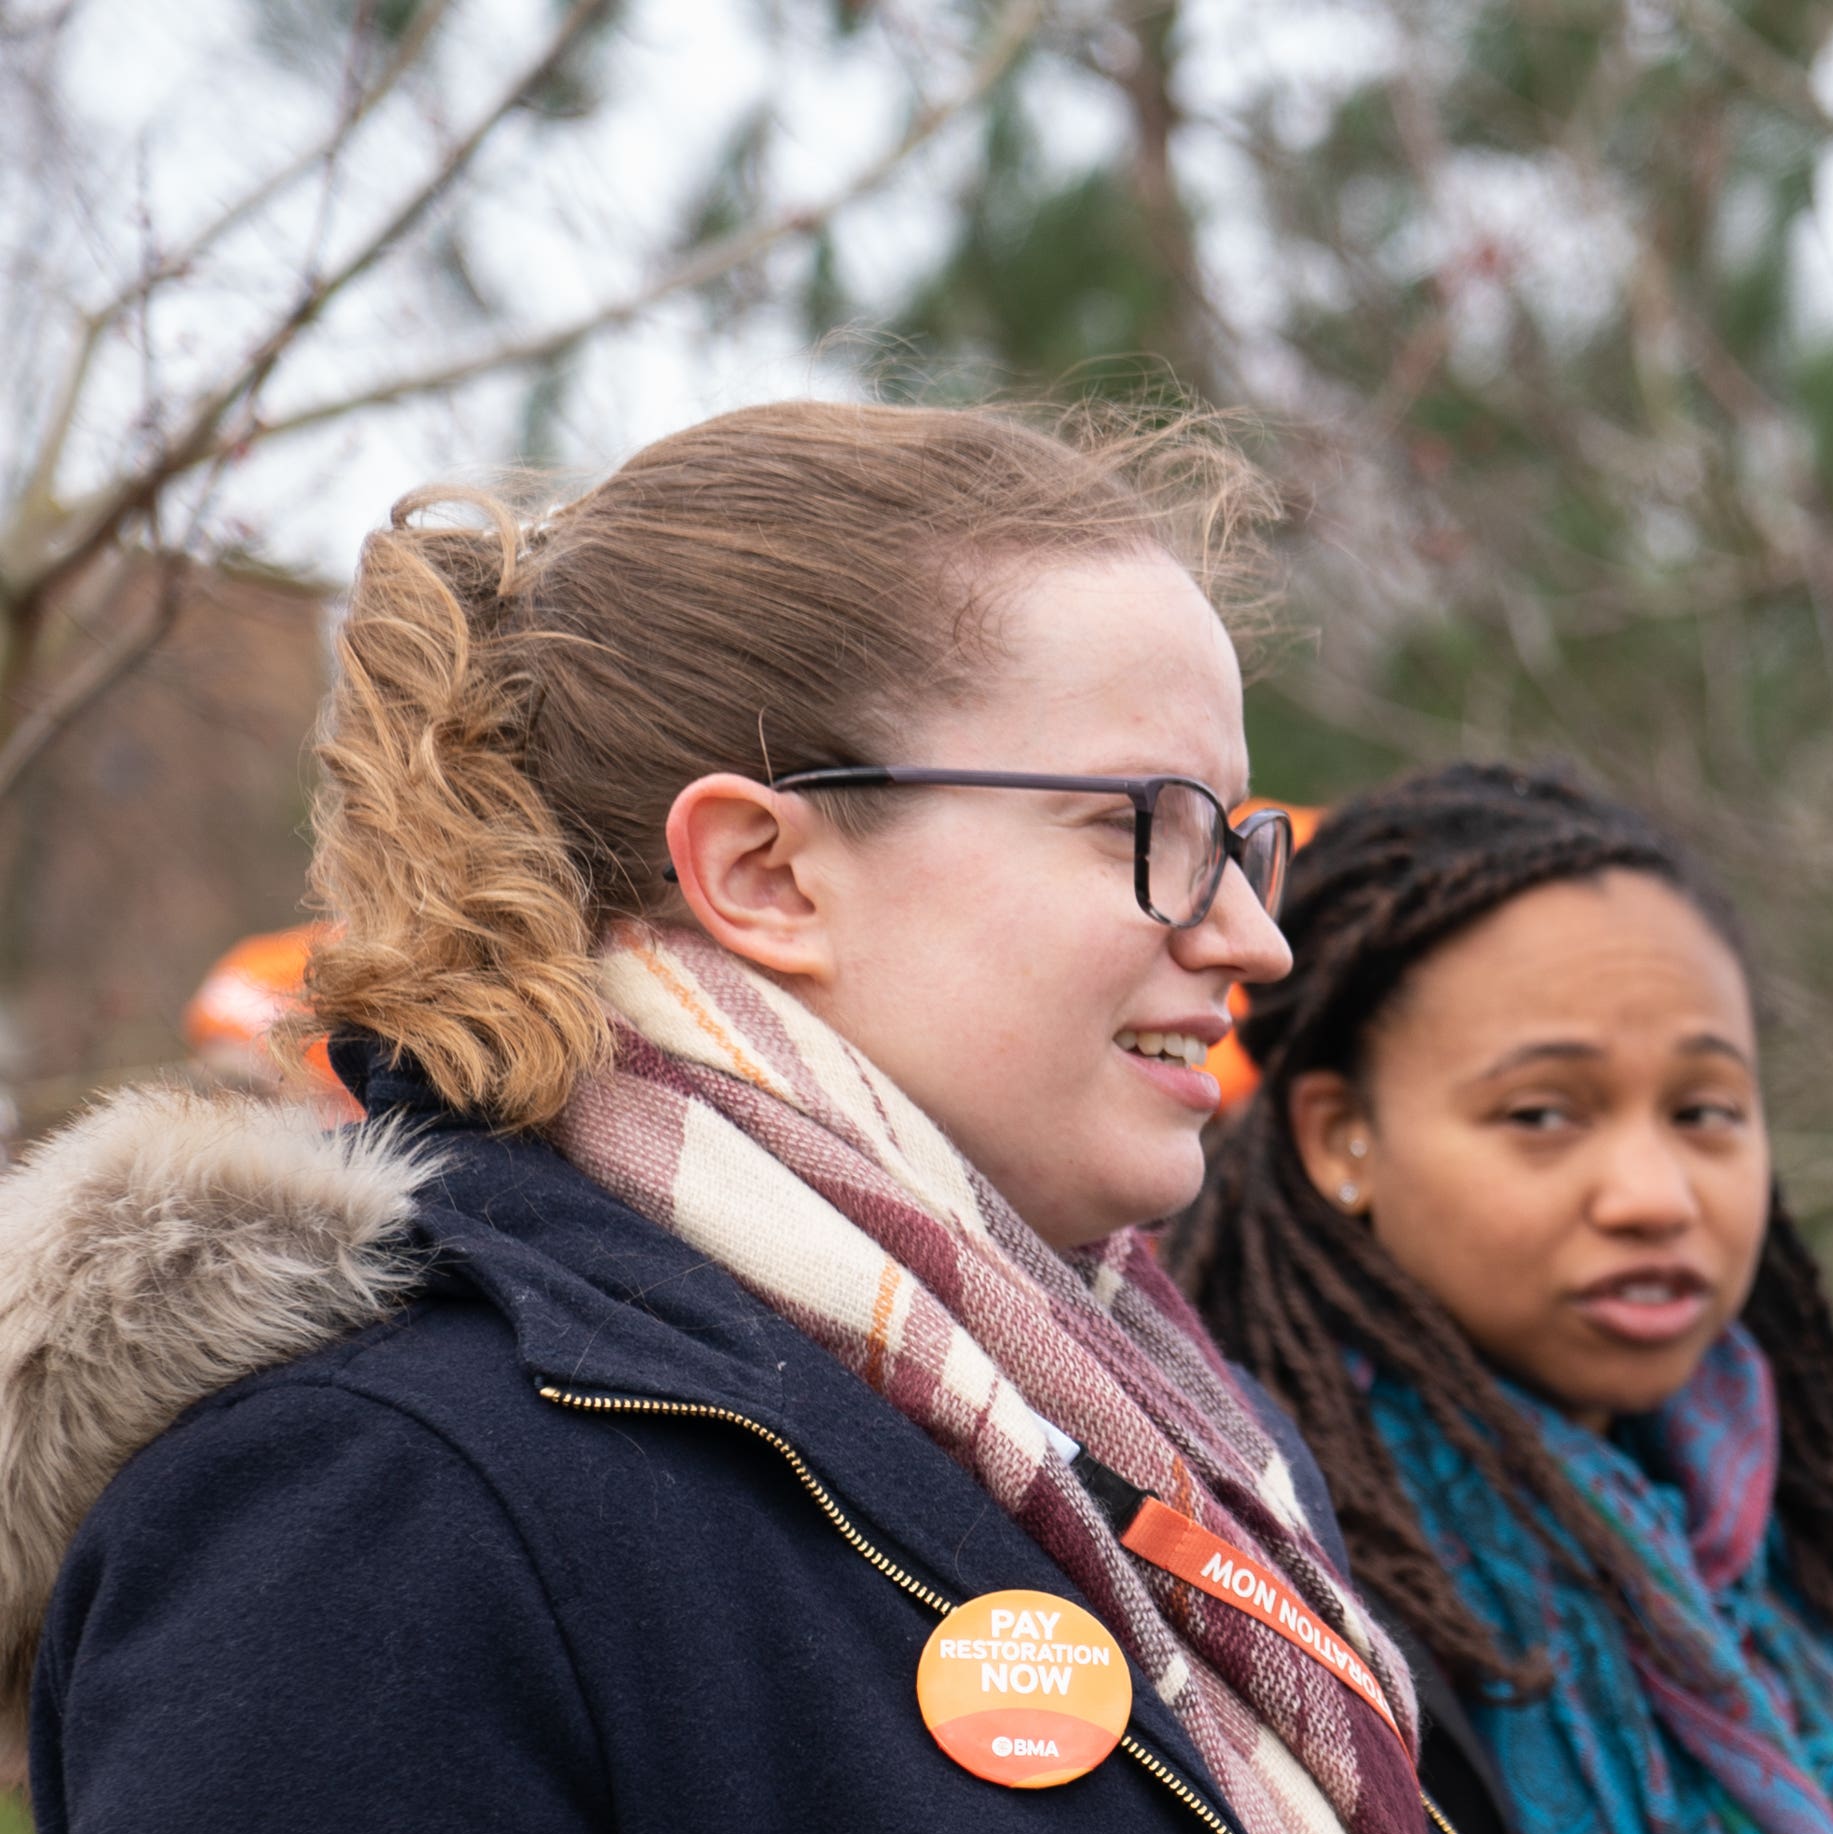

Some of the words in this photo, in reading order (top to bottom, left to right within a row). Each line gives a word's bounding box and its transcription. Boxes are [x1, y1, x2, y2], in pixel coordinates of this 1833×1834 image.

[1200, 1551, 1277, 1614] NOW
[991, 1608, 1061, 1641] PAY
[939, 1639, 1110, 1666] RESTORATION
[1278, 1598, 1392, 1716] TORATION
[980, 1663, 1073, 1696] NOW
[1013, 1738, 1060, 1758] BMA
